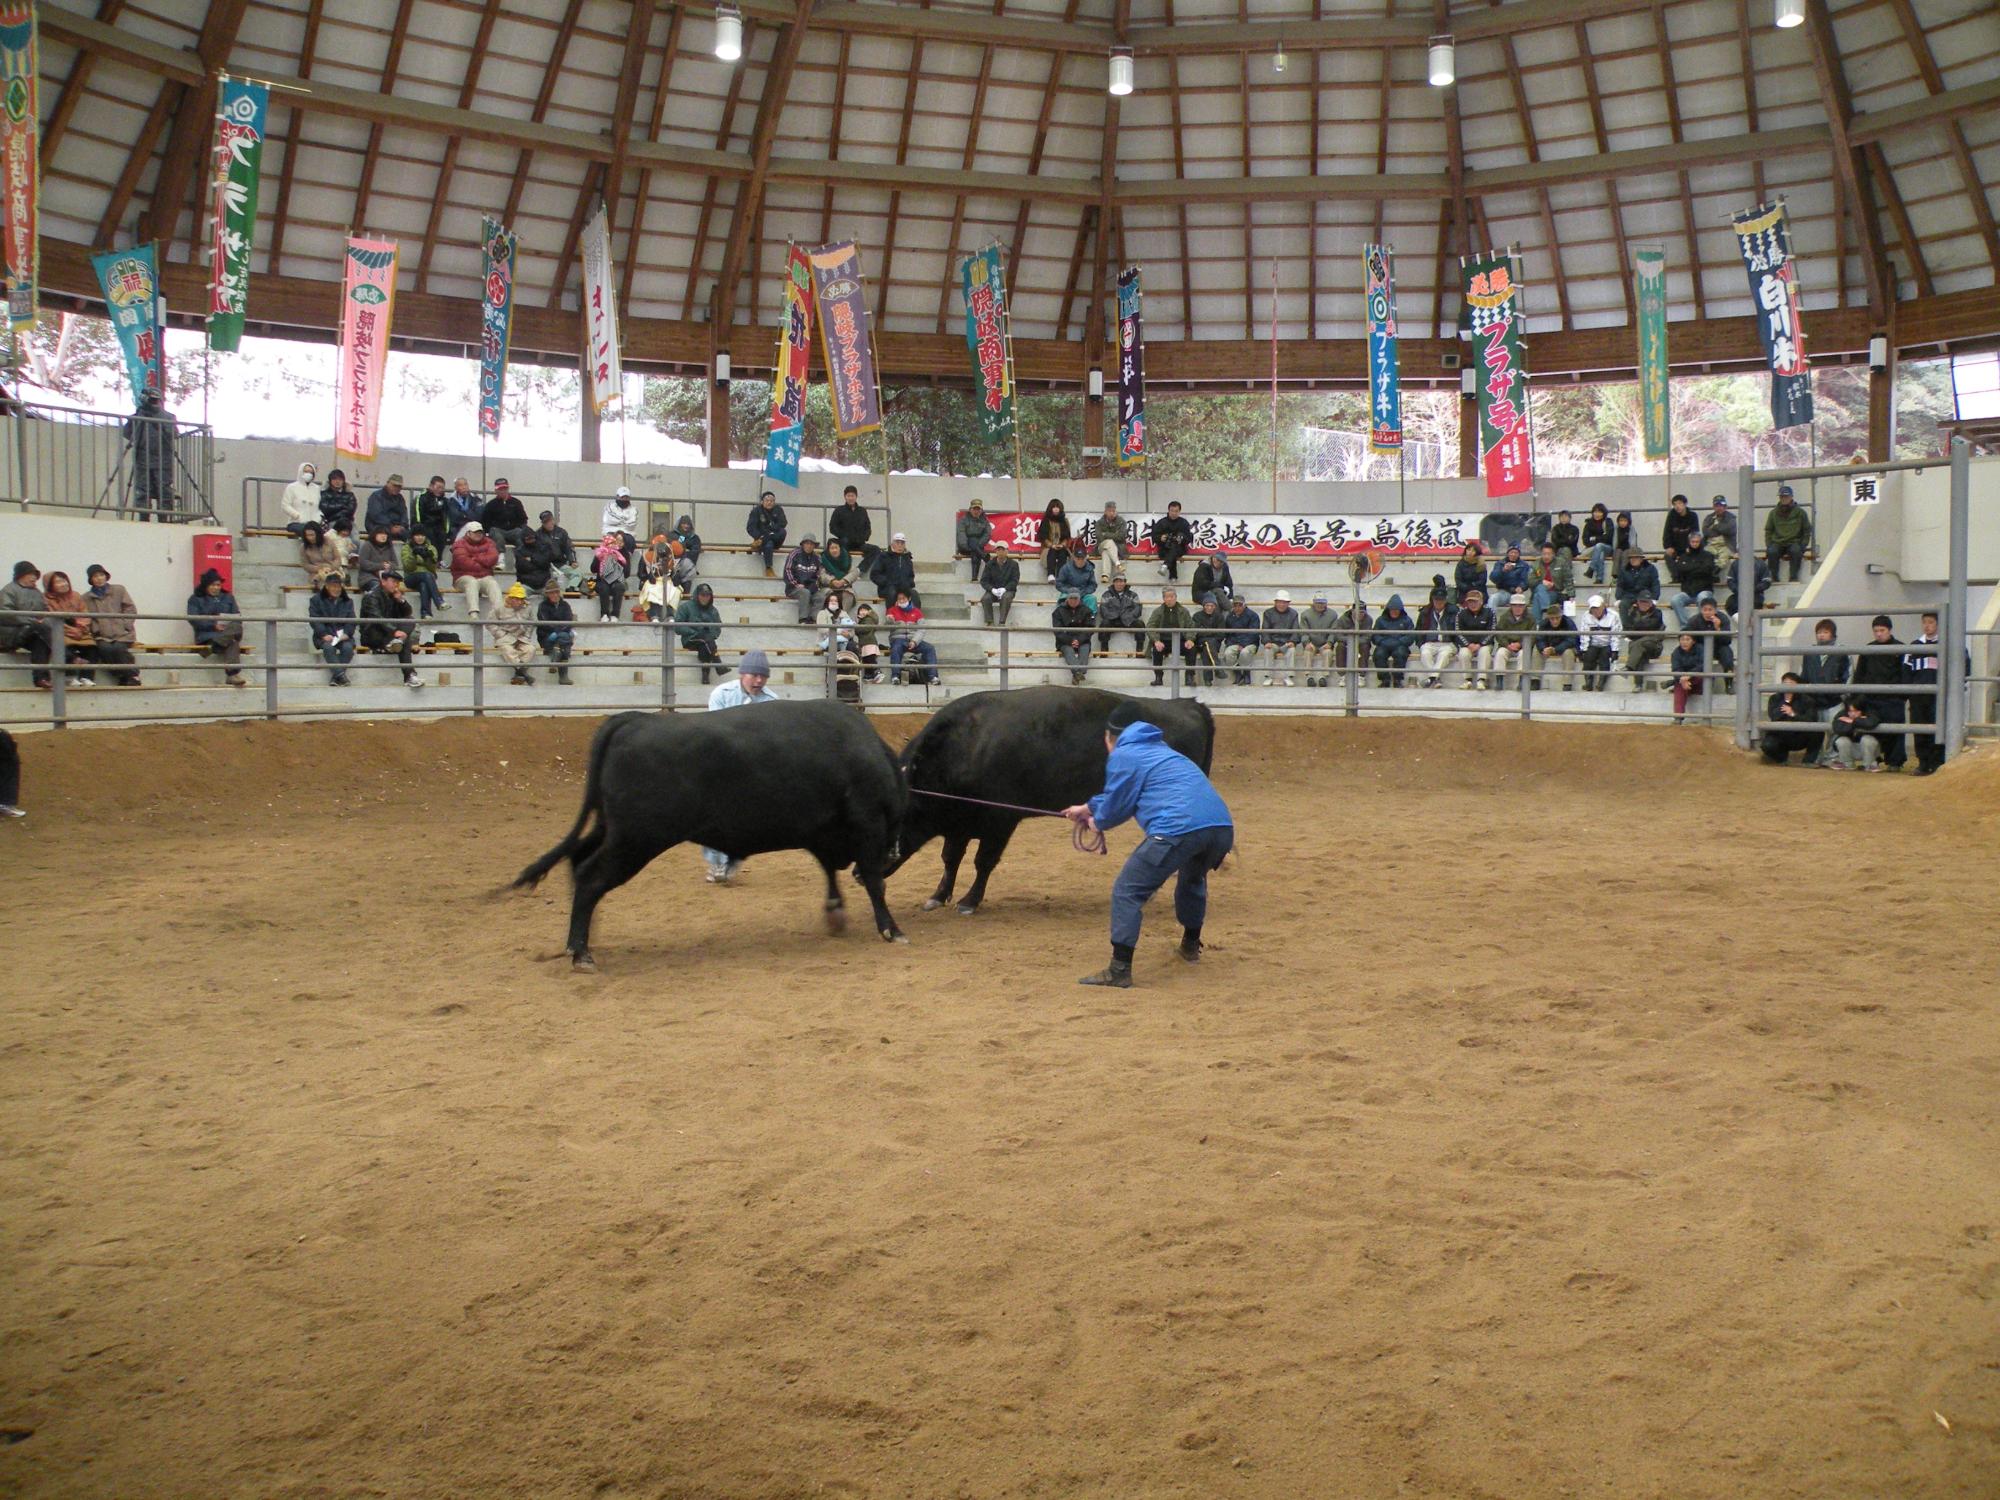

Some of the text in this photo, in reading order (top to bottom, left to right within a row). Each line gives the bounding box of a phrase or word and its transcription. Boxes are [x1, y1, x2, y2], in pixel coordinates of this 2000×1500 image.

[1469, 266, 1510, 297] 必勝
[831, 301, 867, 424] 隠岐プラザホテル
[1481, 315, 1519, 436] プラザ号
[1854, 479, 1876, 501] 東
[1188, 517, 1467, 549] 隠岐の島号・島後嵐
